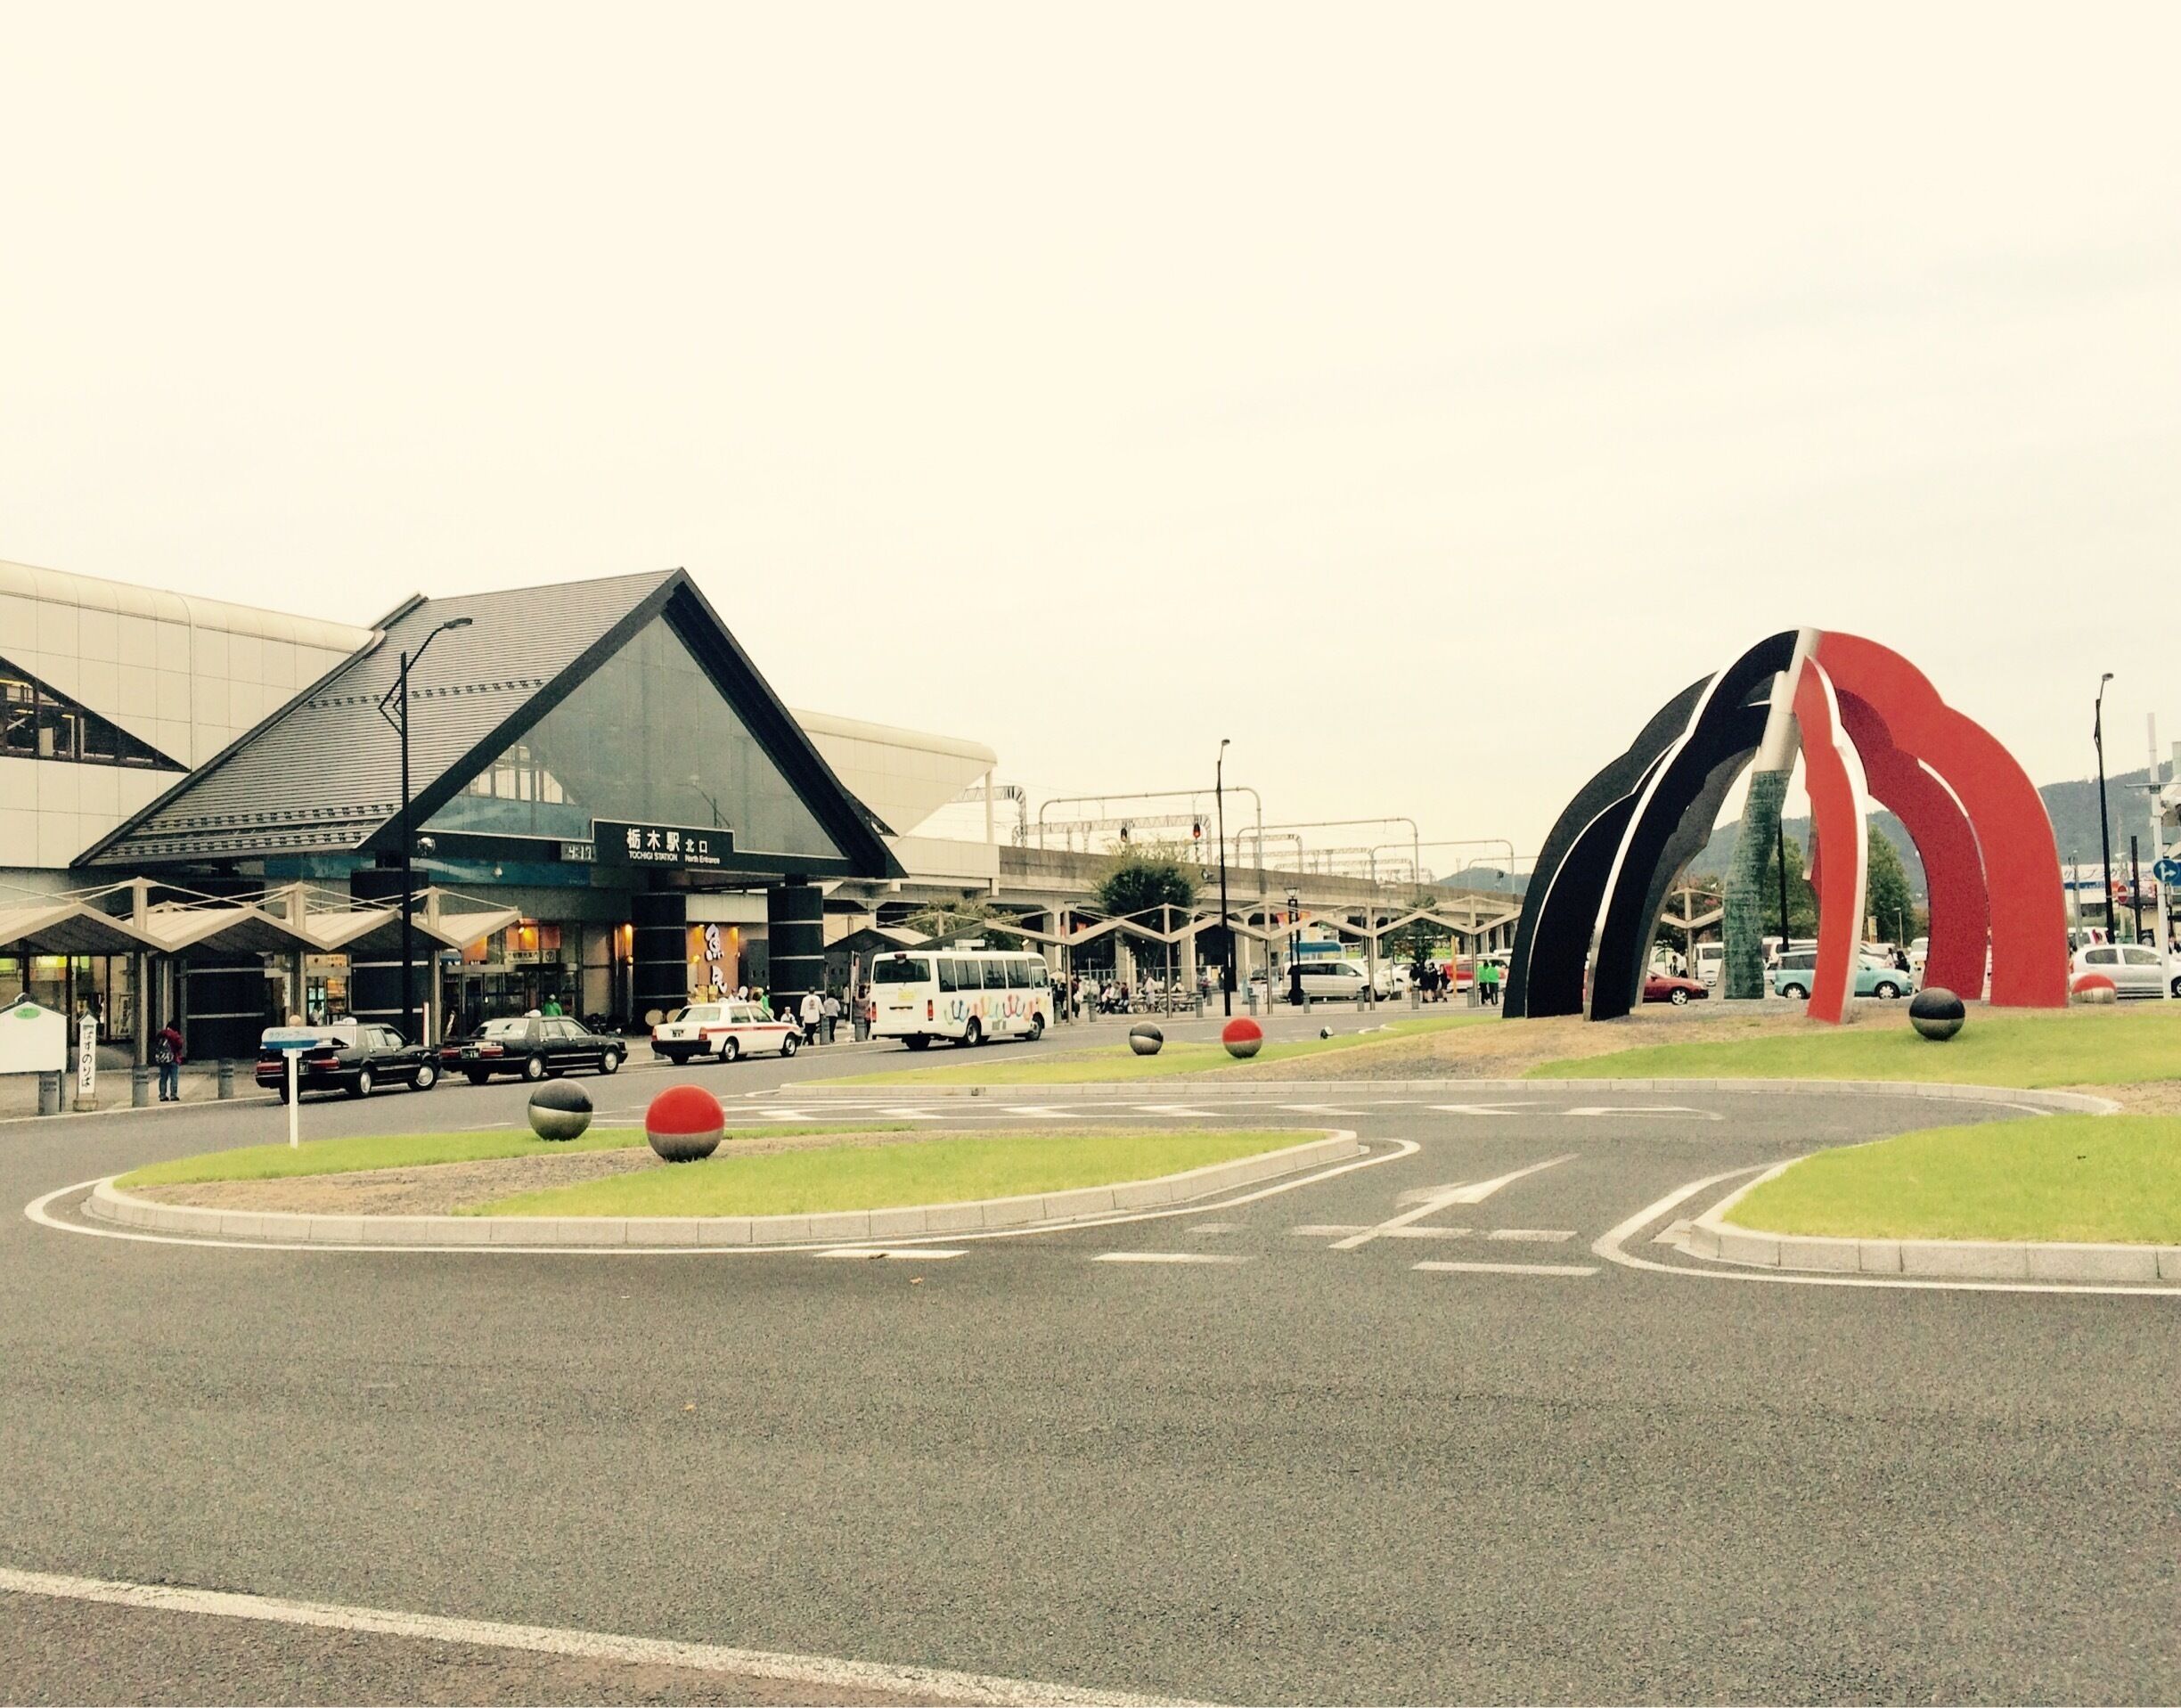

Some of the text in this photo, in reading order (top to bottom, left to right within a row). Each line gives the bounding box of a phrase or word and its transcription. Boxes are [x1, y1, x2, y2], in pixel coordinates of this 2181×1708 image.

[626, 828, 708, 854] 栃木駅 北口
[568, 845, 592, 861] 4:17
[627, 850, 678, 862] TOCHIGI STATION
[684, 854, 721, 864] North Entrance
